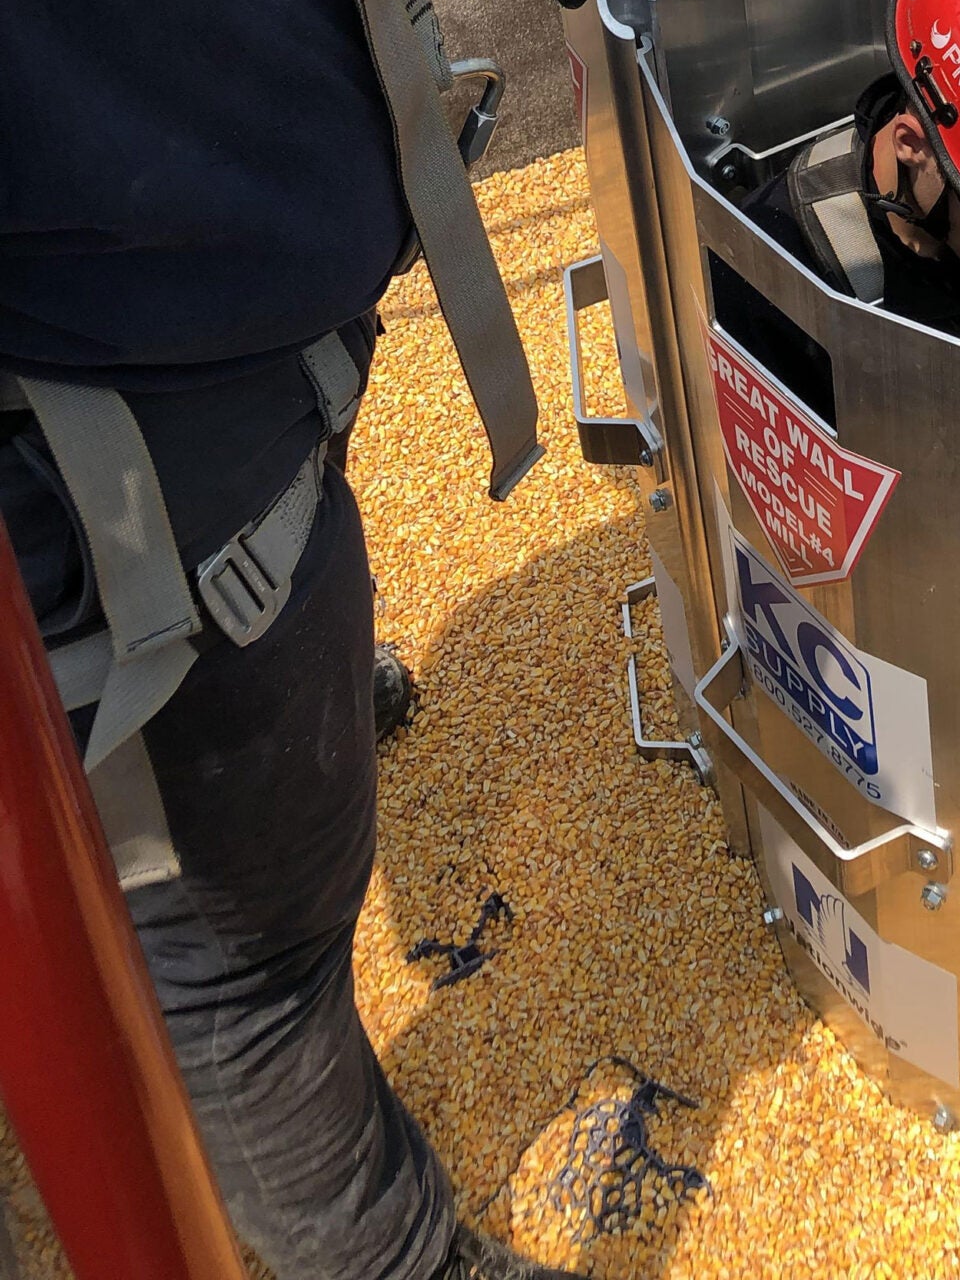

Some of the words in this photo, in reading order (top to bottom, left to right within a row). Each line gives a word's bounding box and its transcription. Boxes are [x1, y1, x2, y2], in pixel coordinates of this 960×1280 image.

[735, 424, 833, 538] RESCUE
[764, 426, 795, 470] OF
[785, 416, 864, 502] WALL
[740, 464, 835, 567] MODEL#4
[765, 509, 813, 569] MILL
[735, 548, 864, 721] KC
[744, 621, 865, 759] SUPPLY
